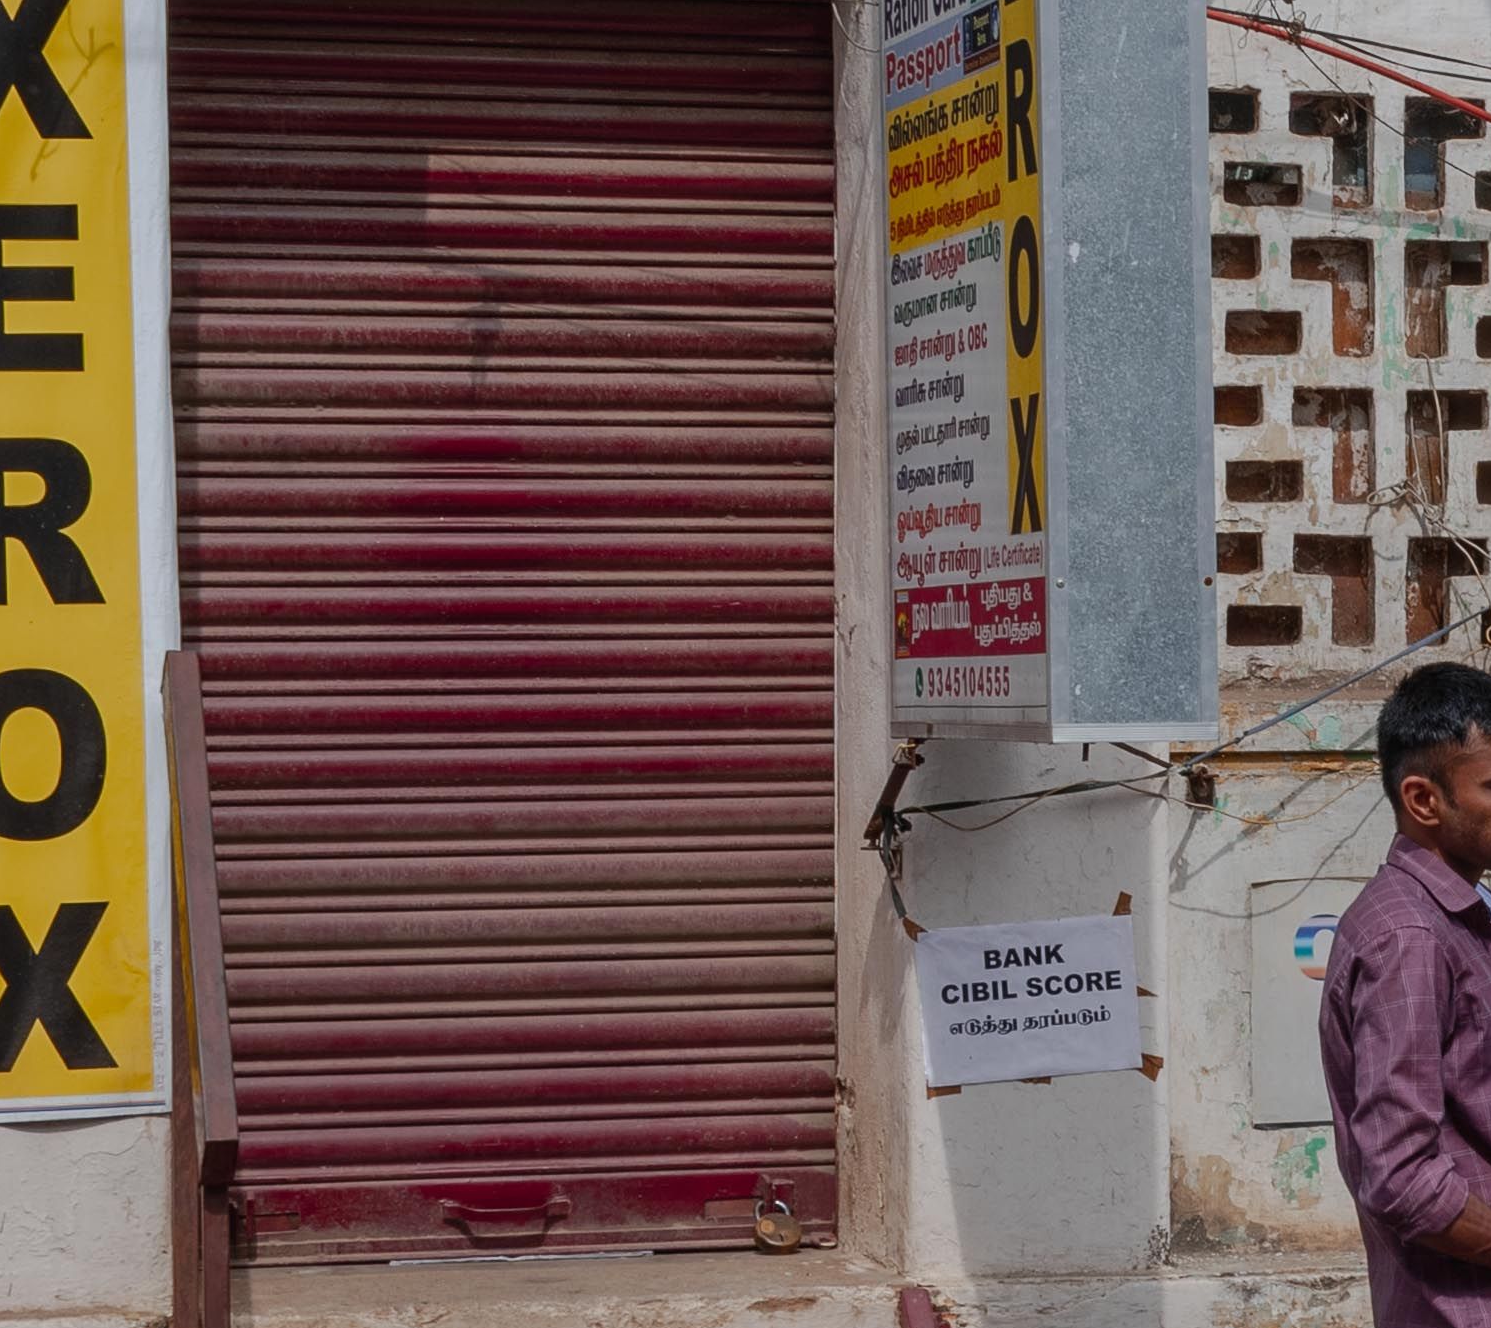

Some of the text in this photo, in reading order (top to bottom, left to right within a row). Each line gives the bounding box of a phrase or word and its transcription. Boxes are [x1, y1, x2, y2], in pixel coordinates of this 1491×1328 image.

[885, 21, 962, 95] Passport
[951, 80, 1000, 125] சான்று
[928, 665, 1010, 697] 9345104555
[983, 944, 1065, 970] BANK
[941, 970, 1123, 1005] CIBIL SCORE
[949, 1005, 1111, 1036] எடுத்து தரப்படும்
